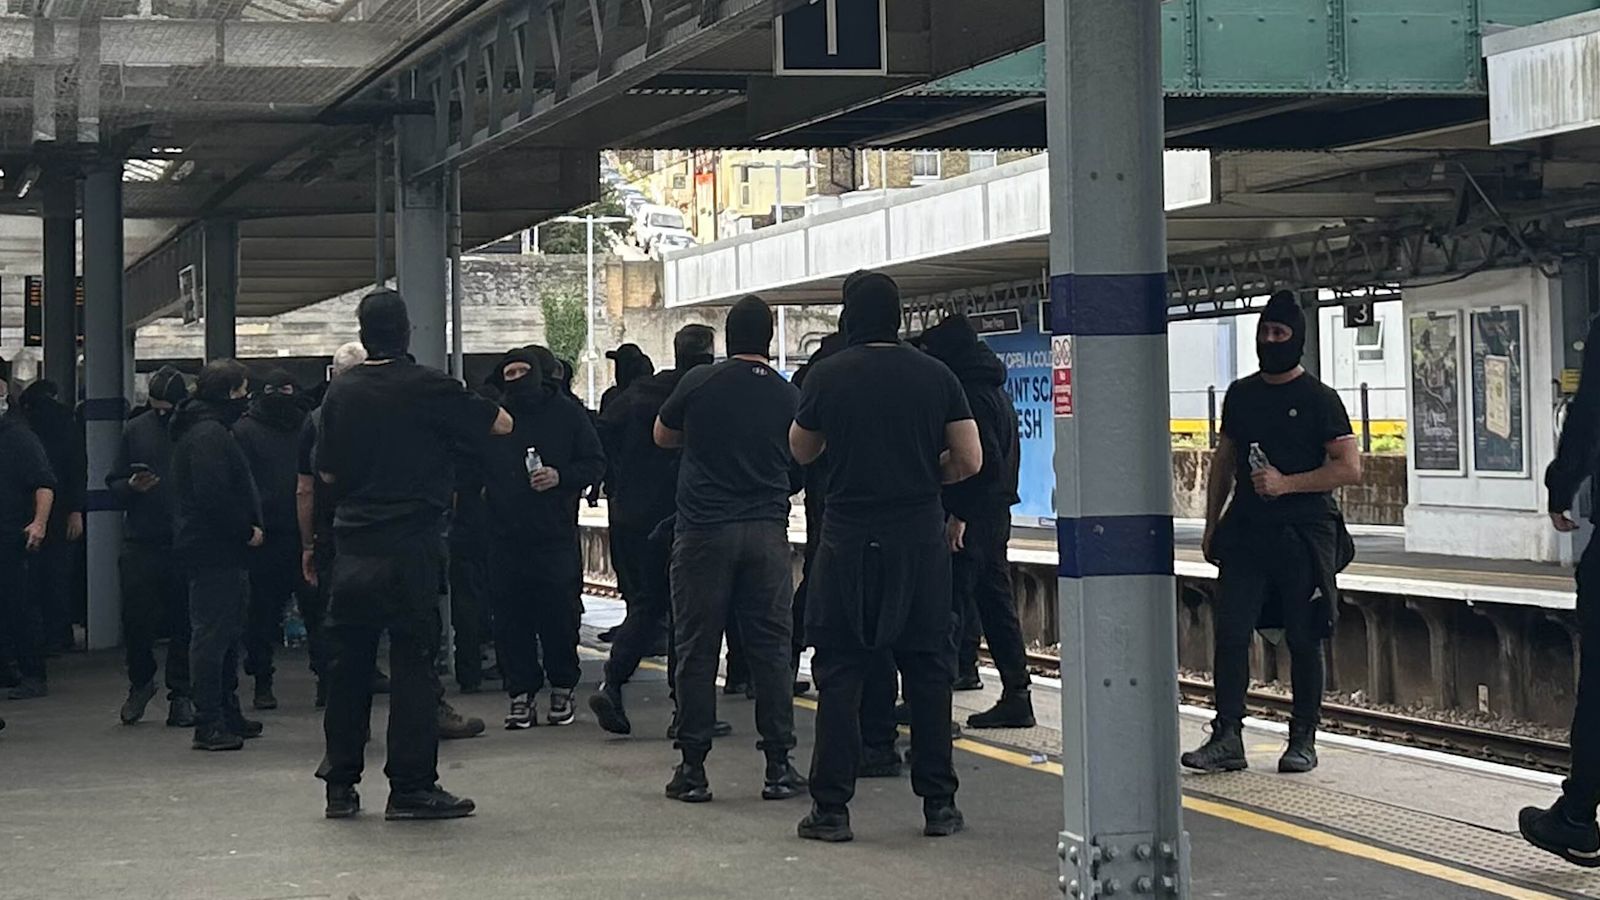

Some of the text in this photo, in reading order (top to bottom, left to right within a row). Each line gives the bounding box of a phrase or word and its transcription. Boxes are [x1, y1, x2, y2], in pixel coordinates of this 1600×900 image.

[809, 0, 838, 55] 1
[1353, 303, 1368, 323] 3
[1006, 351, 1025, 368] OPEN
[1025, 351, 1032, 367] A
